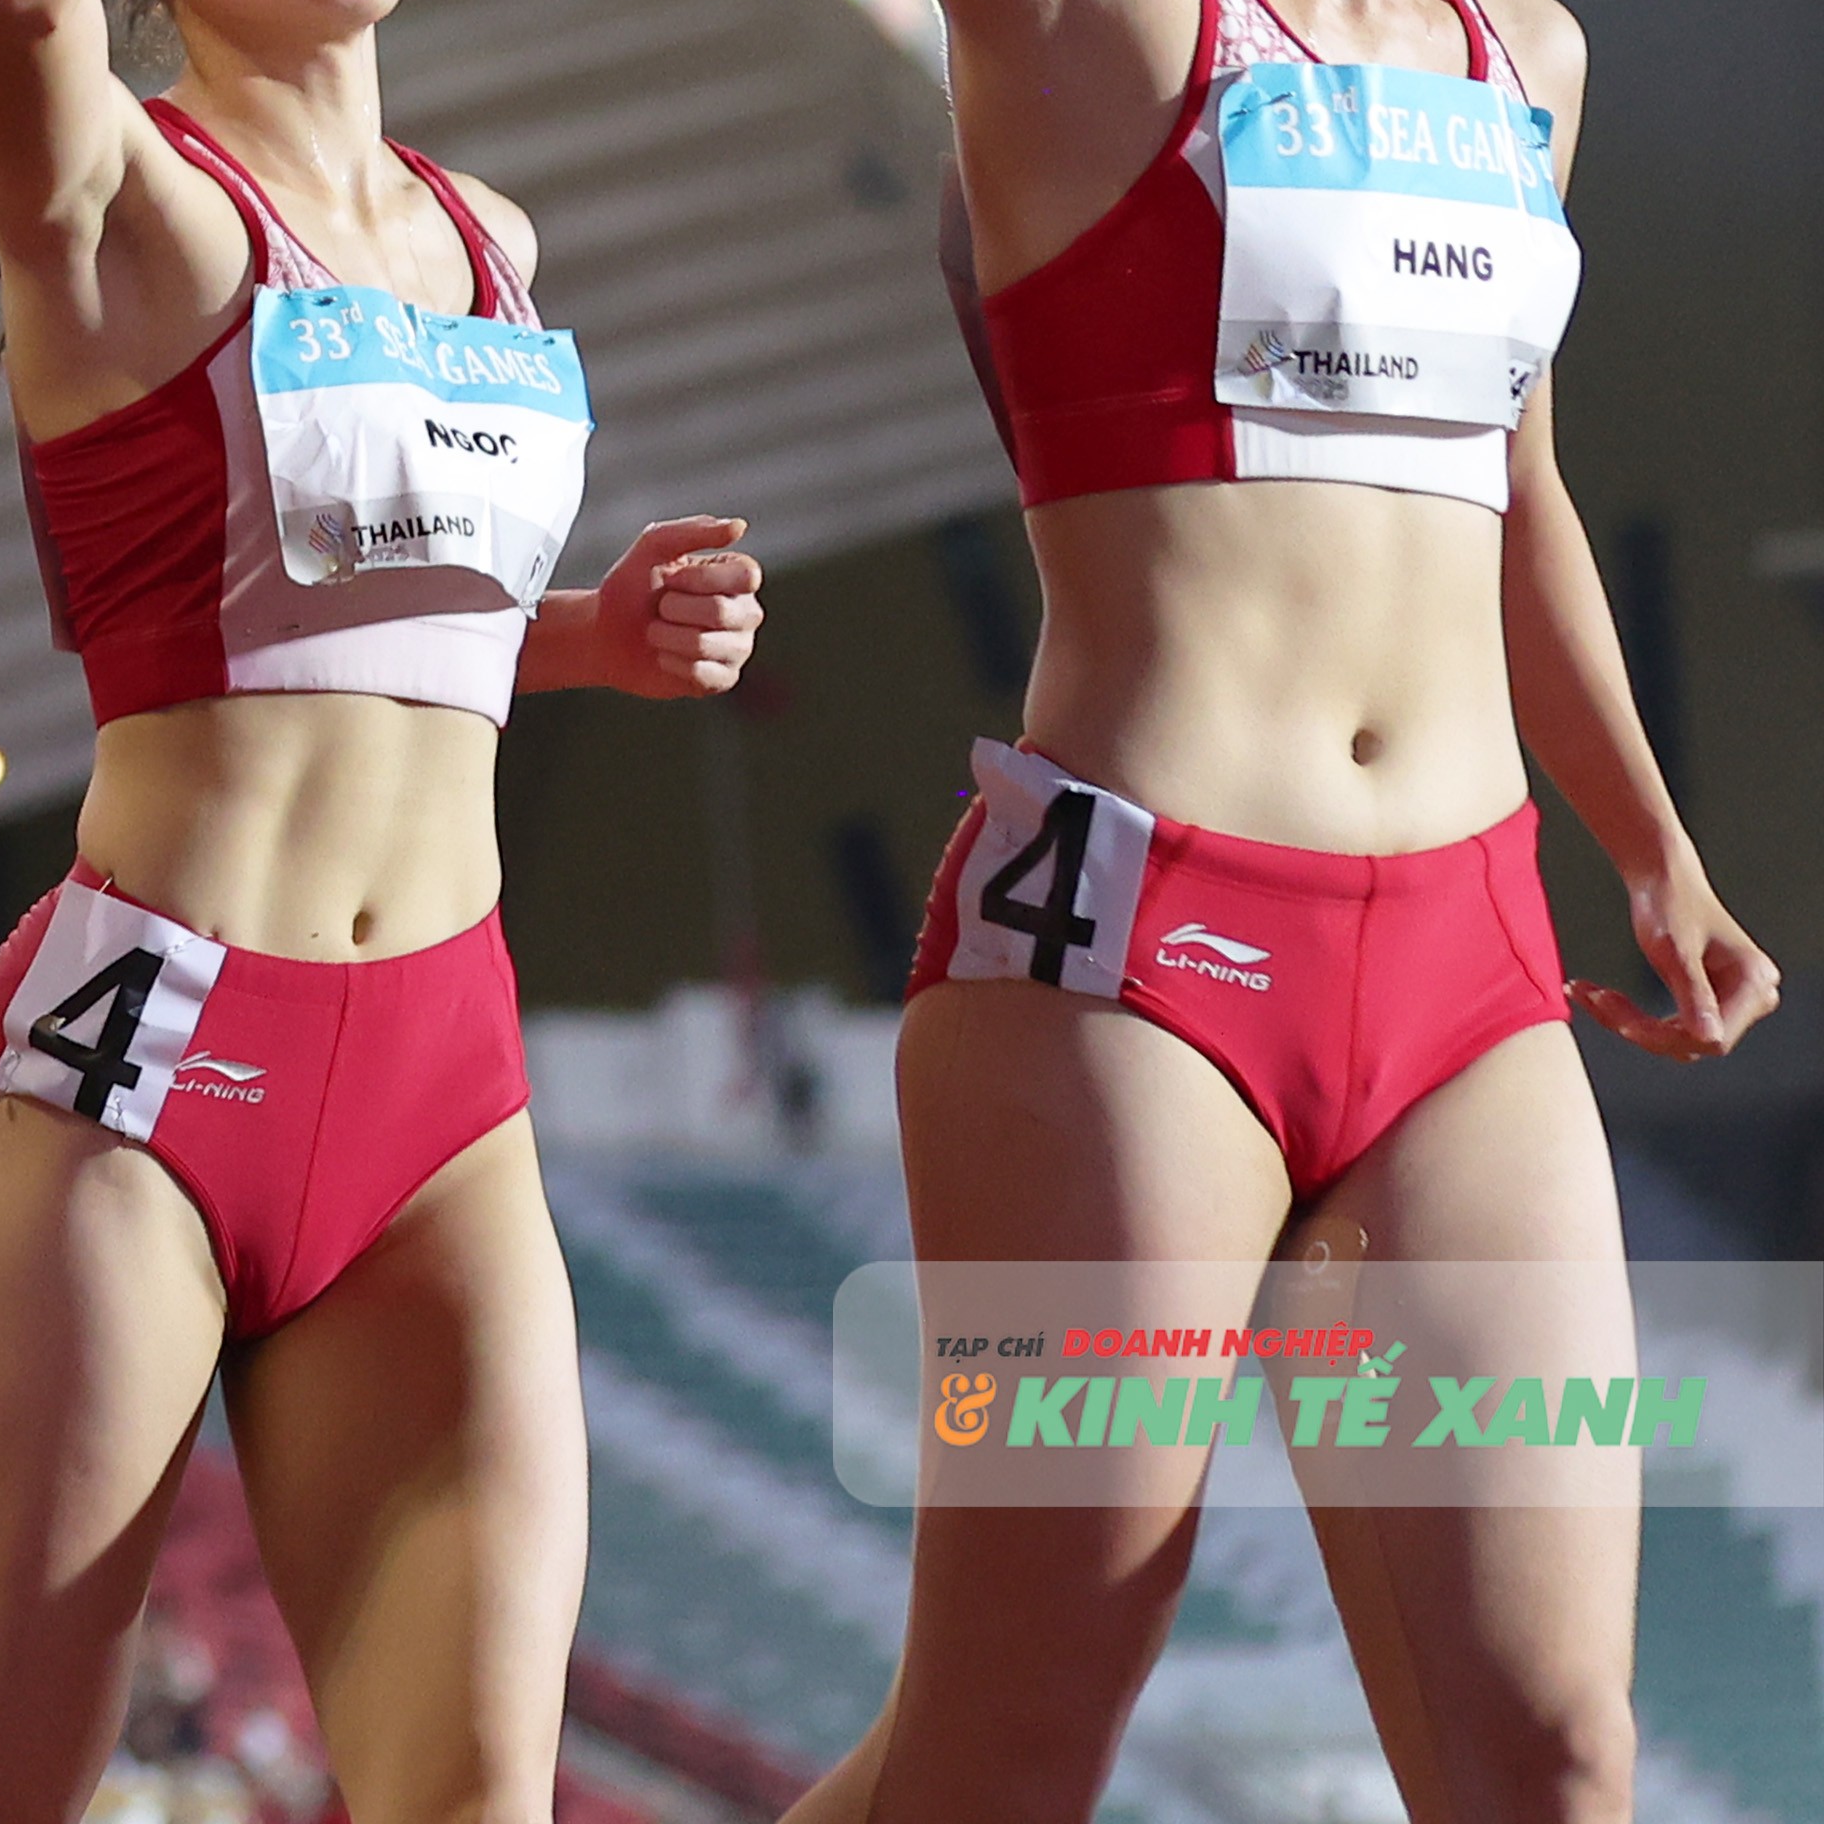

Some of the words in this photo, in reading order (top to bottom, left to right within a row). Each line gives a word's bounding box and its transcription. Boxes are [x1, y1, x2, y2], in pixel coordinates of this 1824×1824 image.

[1369, 104, 1439, 166] SEA
[1393, 238, 1494, 281] HANG
[290, 302, 364, 363] 33rd
[435, 341, 562, 395] GAMES
[1293, 350, 1419, 380] THAILAND
[424, 419, 519, 464] NGOC
[351, 515, 475, 546] THAILAND
[981, 788, 1097, 987] 4
[1156, 948, 1272, 992] LI-NING
[29, 946, 164, 1122] 4
